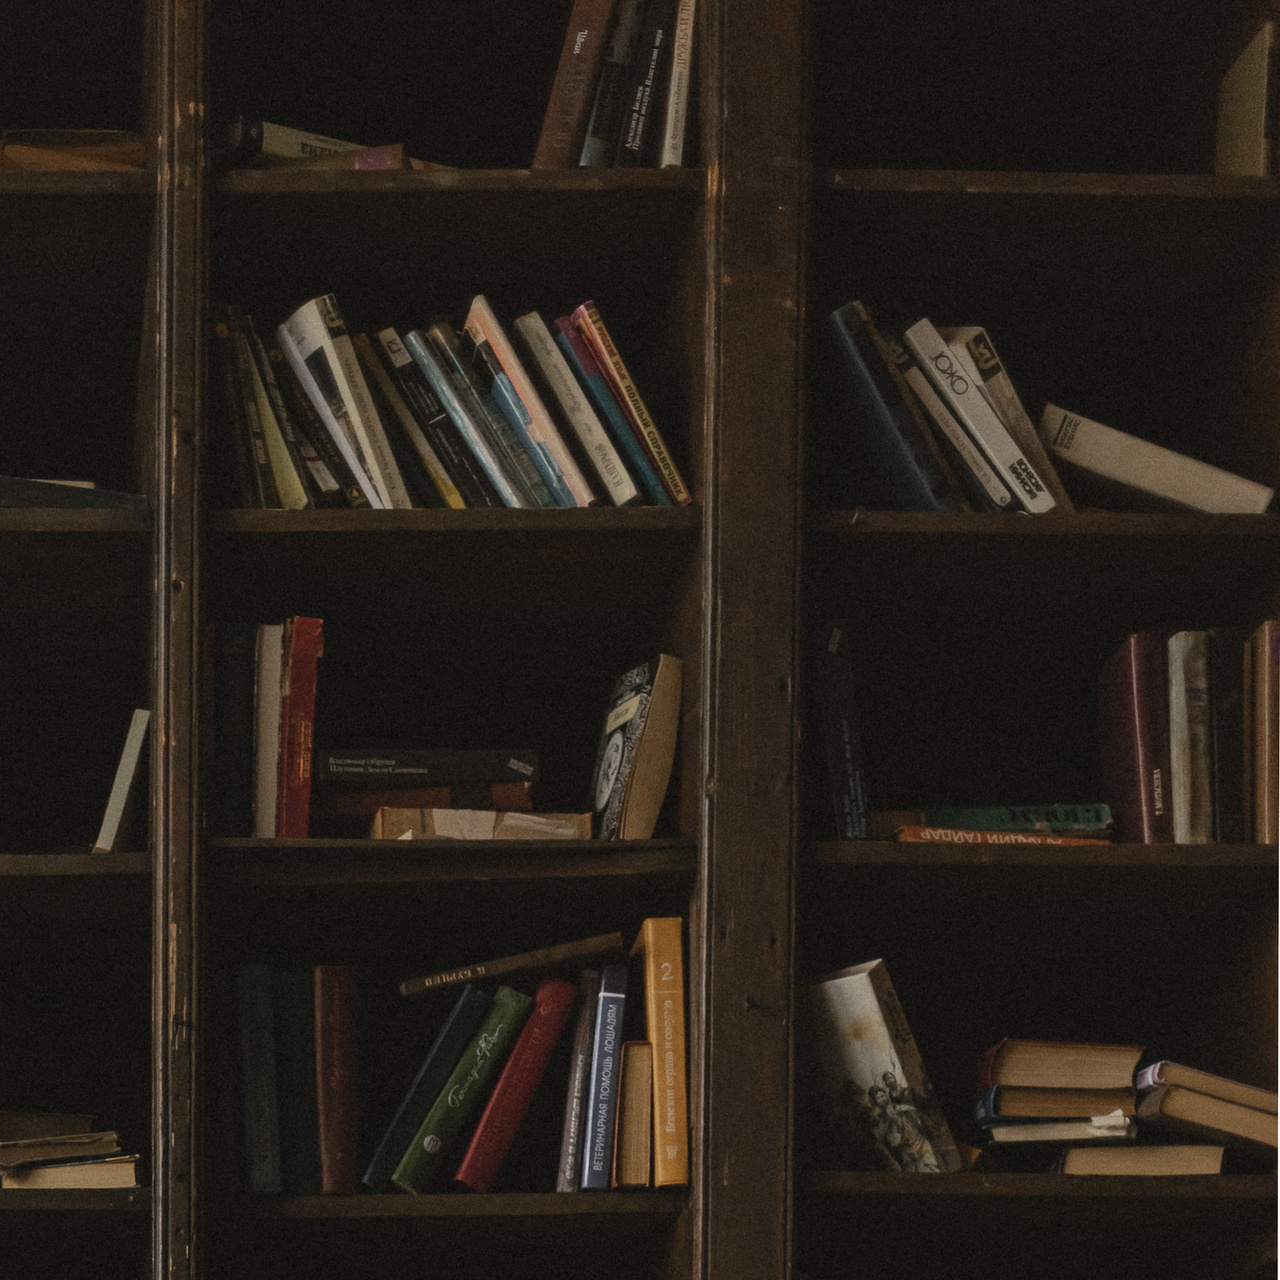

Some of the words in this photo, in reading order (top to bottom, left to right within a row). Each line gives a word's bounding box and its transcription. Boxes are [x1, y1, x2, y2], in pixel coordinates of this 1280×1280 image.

[621, 382, 654, 430] ПОЛНЫЙ
[643, 427, 687, 498] СПРАВОЧНИК
[659, 962, 675, 982] 2
[601, 1002, 621, 1054] ЛОШАДЯМ
[596, 1054, 615, 1100] ПОМОЩЬ
[588, 1101, 612, 1172] ВЕТЕРИНАРНАЯ
